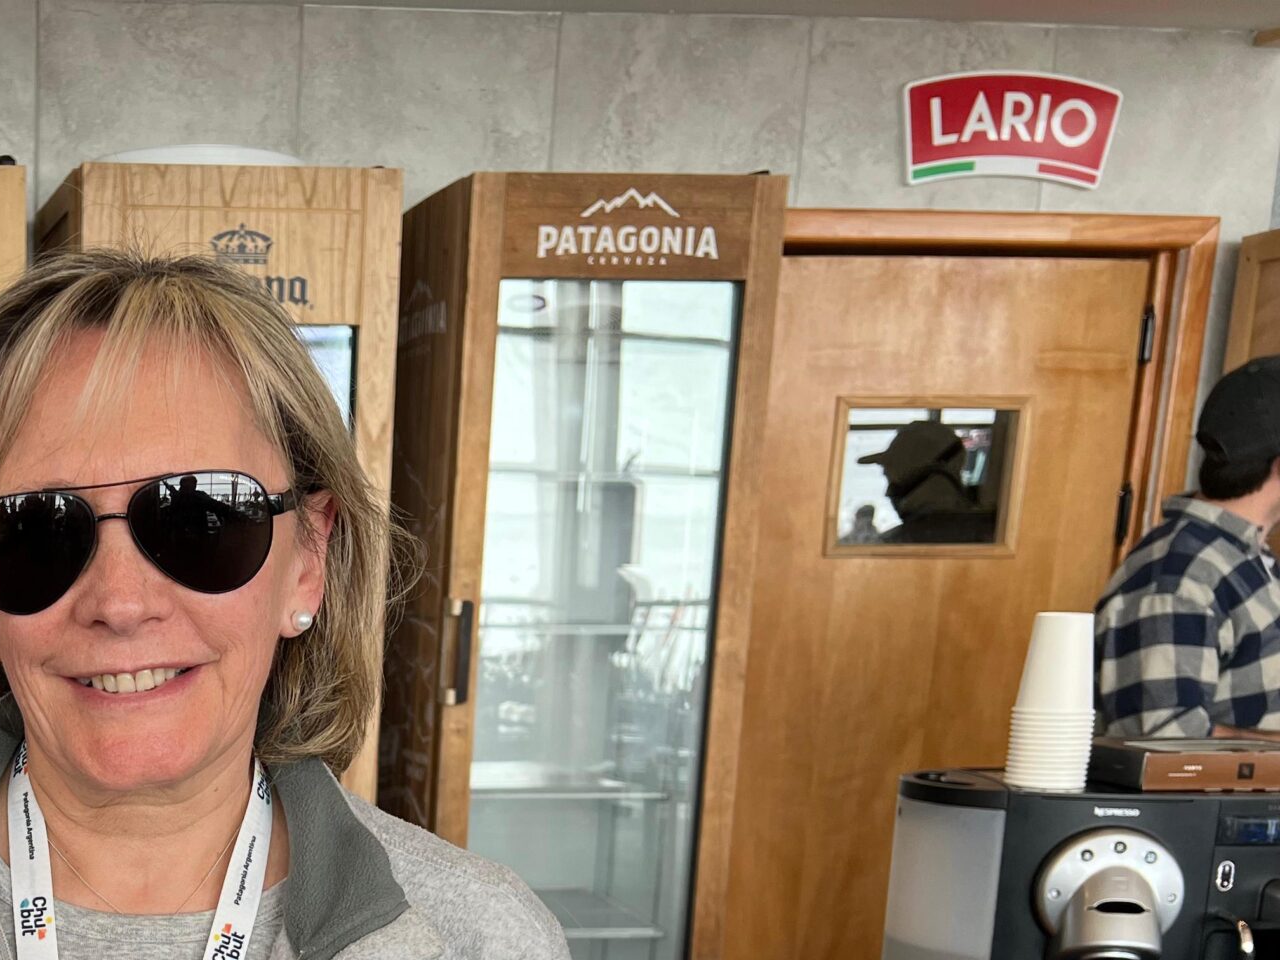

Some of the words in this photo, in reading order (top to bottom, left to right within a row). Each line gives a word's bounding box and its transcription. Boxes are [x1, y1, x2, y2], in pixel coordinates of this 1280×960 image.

[929, 90, 1098, 148] LARIO
[536, 225, 719, 260] PATAGONIA
[234, 869, 248, 906] Patagonia
[244, 834, 257, 872] Argentina
[20, 908, 36, 936] but
[31, 896, 47, 929] Chu
[226, 931, 245, 960] but
